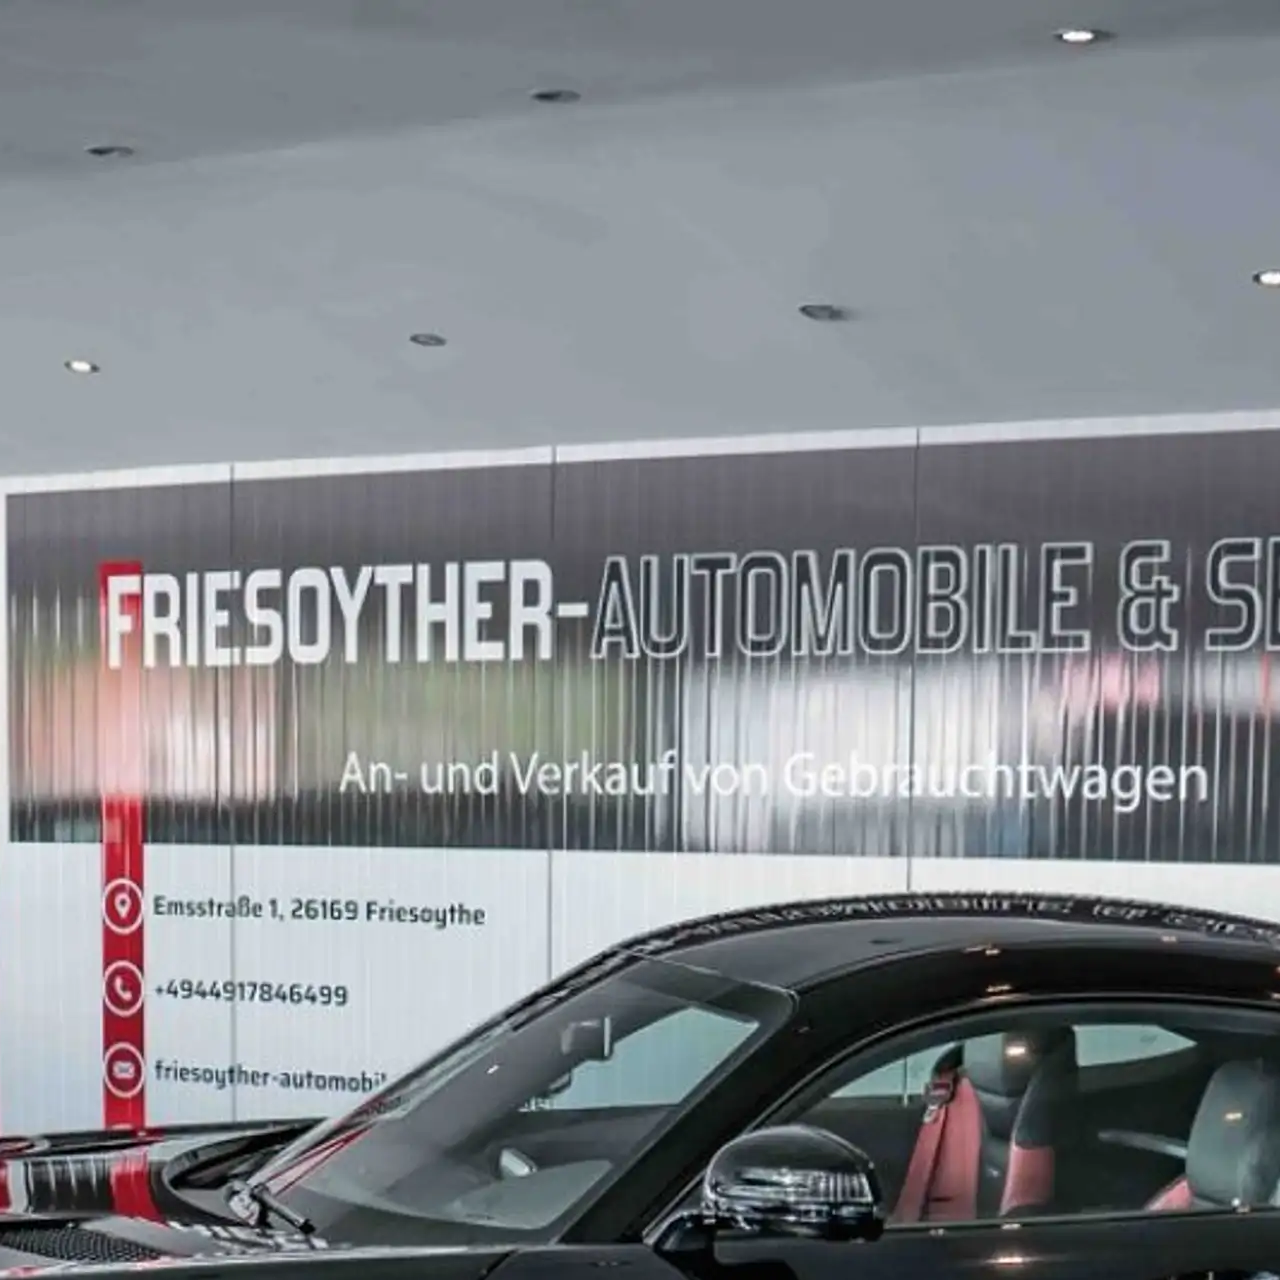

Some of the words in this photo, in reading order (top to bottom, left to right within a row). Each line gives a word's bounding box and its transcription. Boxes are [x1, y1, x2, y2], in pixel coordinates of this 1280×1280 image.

[1117, 538, 1180, 653] &
[338, 750, 409, 794] An-
[421, 750, 498, 795] und
[509, 748, 677, 796] Verkauf
[683, 762, 768, 796] von
[782, 752, 1210, 813] Gebrauchtwagen
[152, 895, 263, 918] Emsstraße
[269, 898, 285, 921] 1,
[291, 899, 359, 921] 26169
[366, 901, 486, 929] Friesoythe
[154, 979, 349, 1006] +4944917846499
